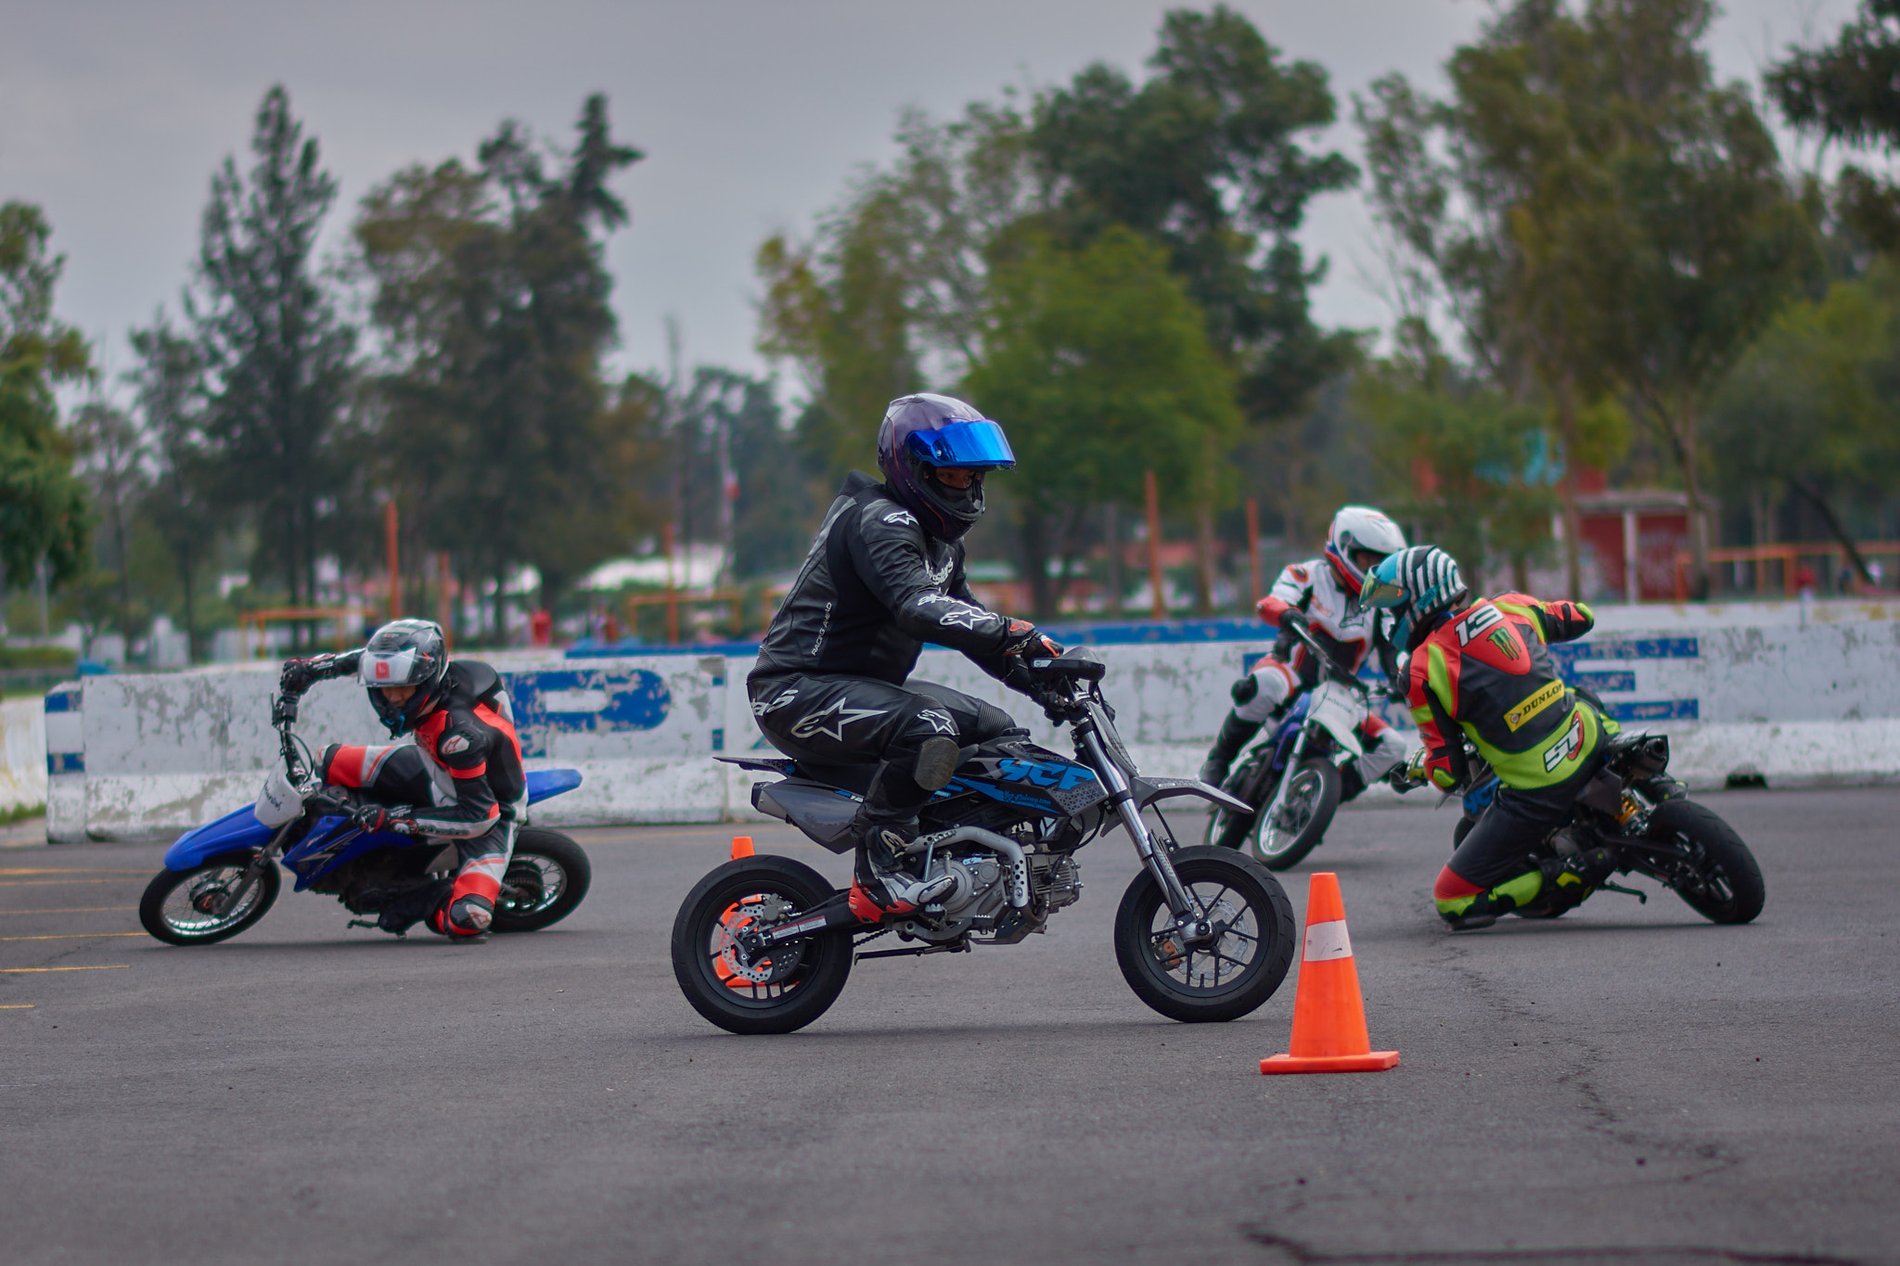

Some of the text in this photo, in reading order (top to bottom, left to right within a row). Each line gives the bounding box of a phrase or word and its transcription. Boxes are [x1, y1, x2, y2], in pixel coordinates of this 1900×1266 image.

[811, 628, 826, 656] RACIG
[1455, 604, 1504, 648] 13
[1521, 684, 1563, 716] DUNLOP
